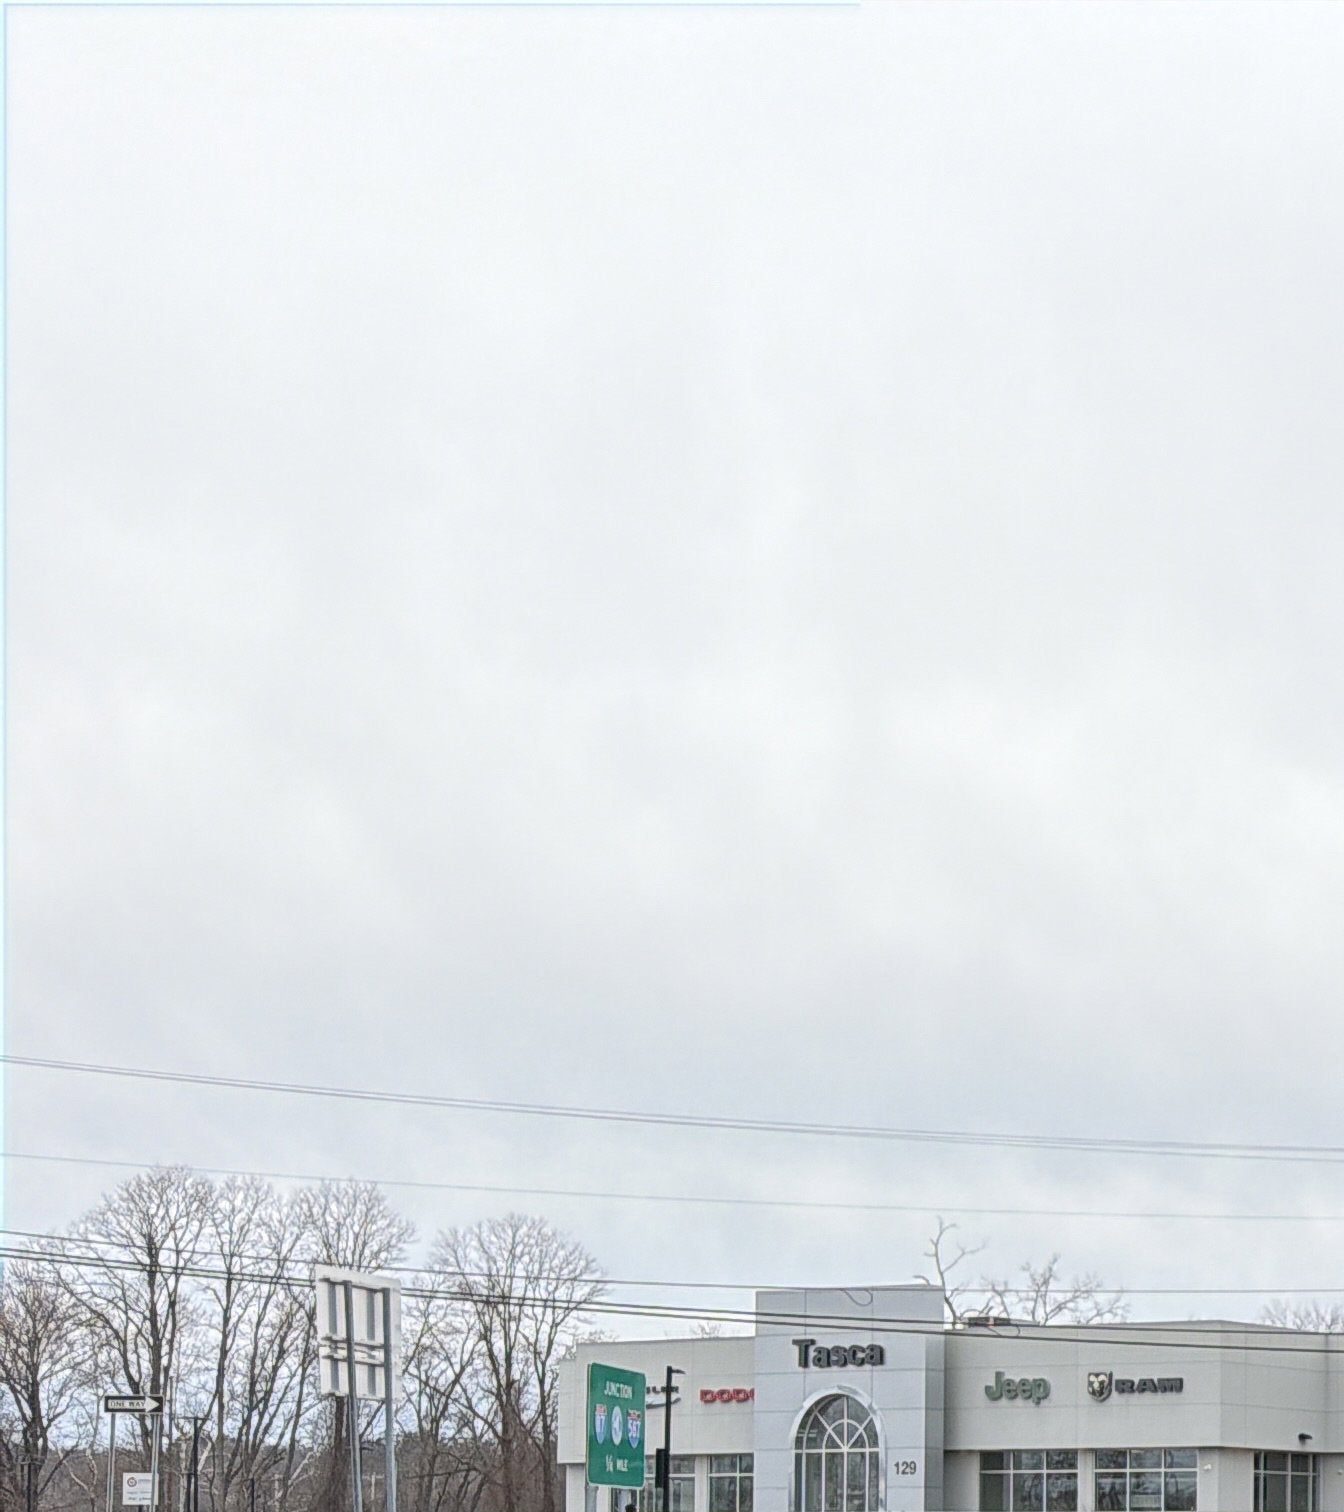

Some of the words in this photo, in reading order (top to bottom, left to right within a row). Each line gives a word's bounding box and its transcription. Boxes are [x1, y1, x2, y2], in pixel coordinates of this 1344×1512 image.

[792, 1338, 885, 1369] Tasca
[604, 1381, 633, 1399] JUNCTION
[985, 1371, 1051, 1406] Jeep
[1115, 1378, 1183, 1394] RAM
[110, 1400, 125, 1408] ONE
[129, 1400, 146, 1408] WAY
[894, 1461, 917, 1476] 129
